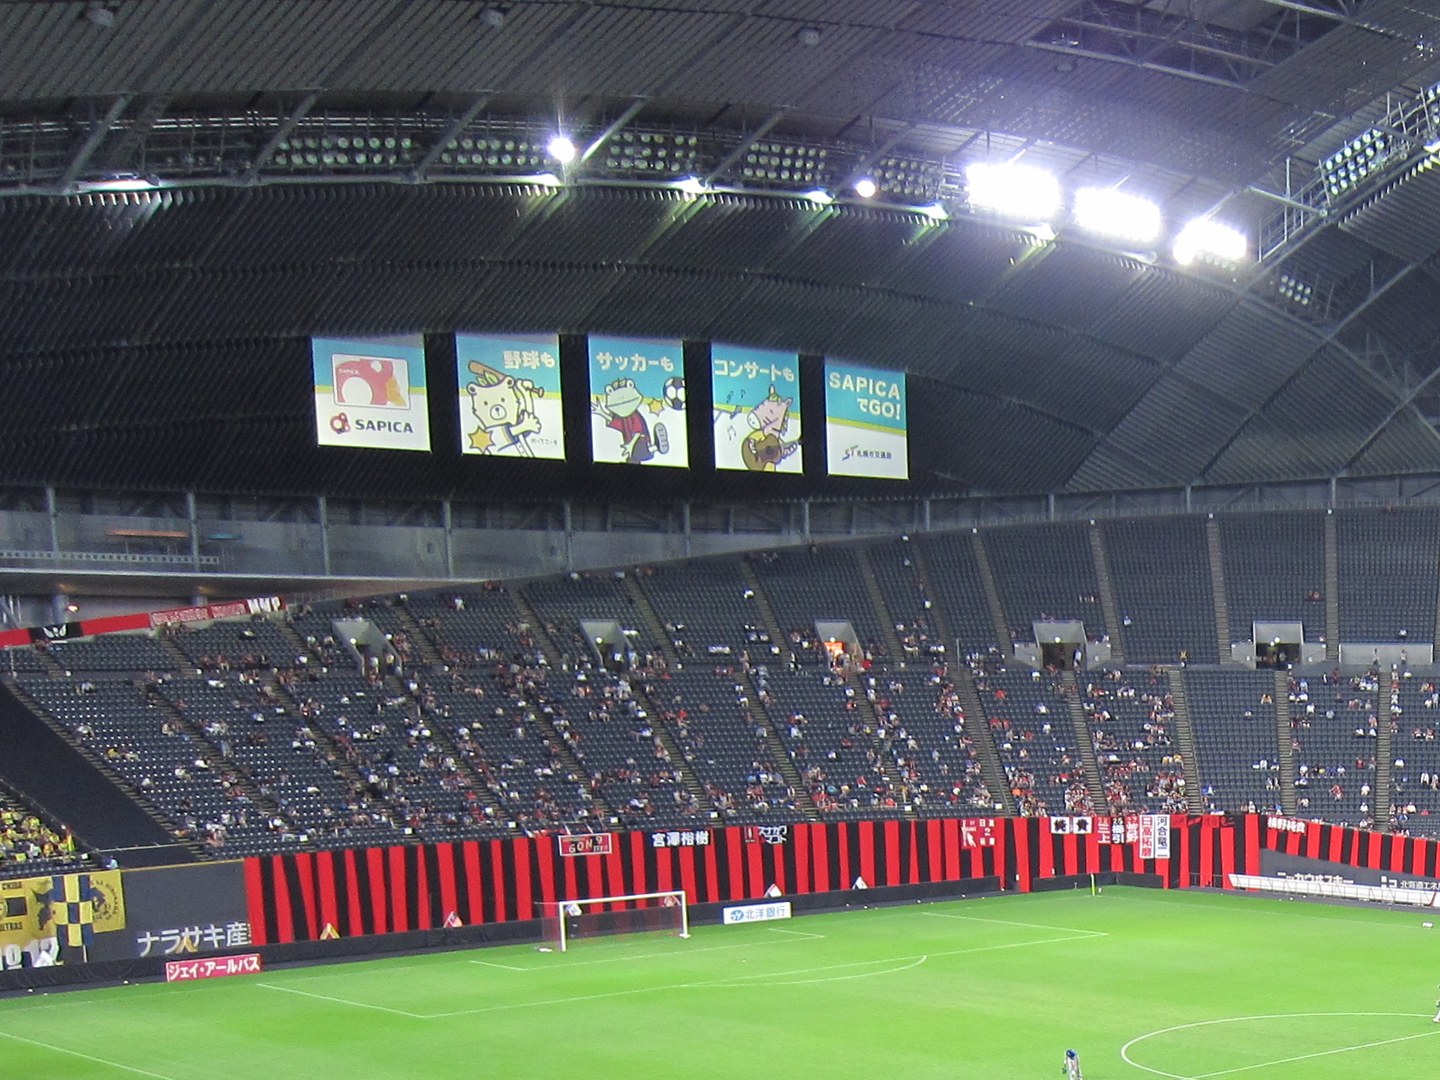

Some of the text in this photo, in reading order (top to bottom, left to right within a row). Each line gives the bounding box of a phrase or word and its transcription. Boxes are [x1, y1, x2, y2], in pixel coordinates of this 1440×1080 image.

[503, 350, 556, 370] 野球も
[596, 352, 674, 373] サッカーも
[714, 359, 796, 383] コンサートも
[829, 372, 901, 401] SAPICA
[857, 397, 902, 421] でGO!
[355, 418, 414, 434] SAPICA
[137, 921, 252, 957] ナラサキ産
